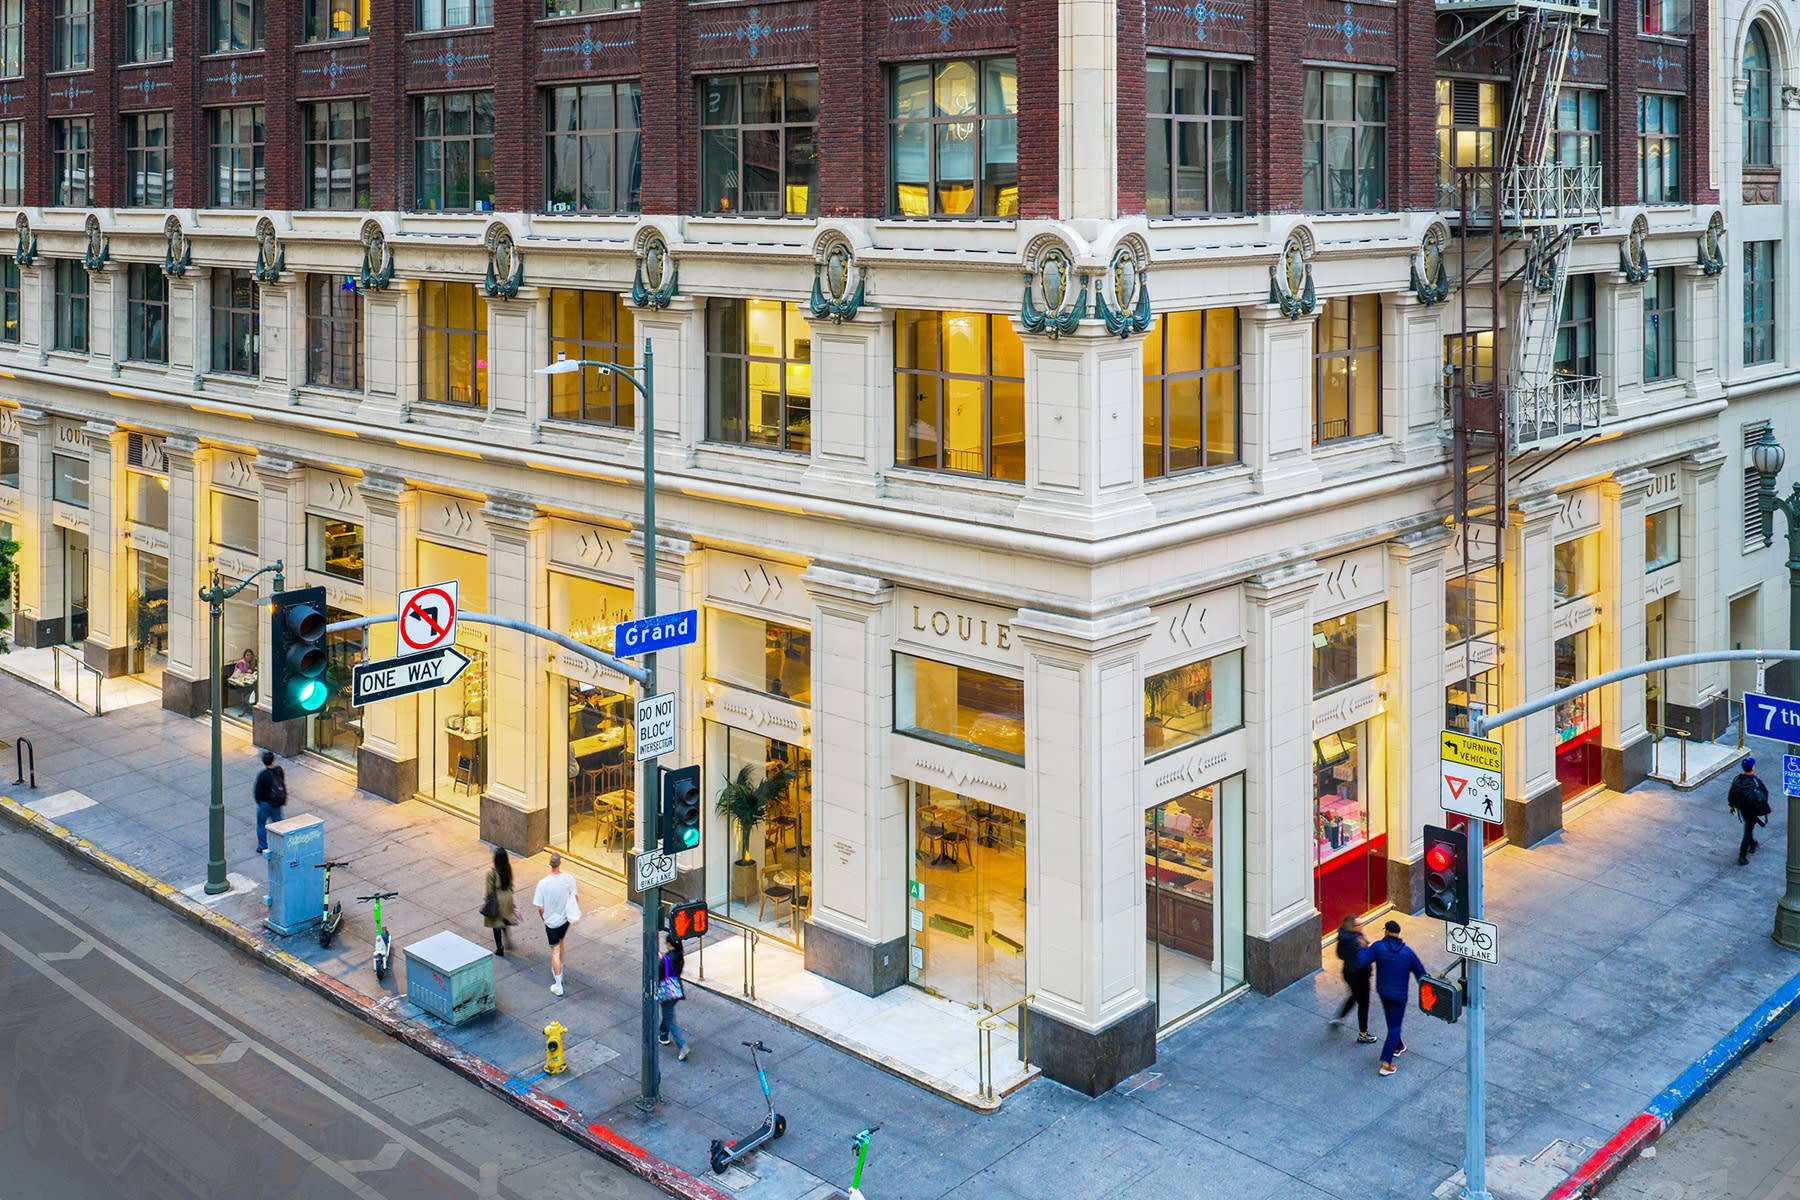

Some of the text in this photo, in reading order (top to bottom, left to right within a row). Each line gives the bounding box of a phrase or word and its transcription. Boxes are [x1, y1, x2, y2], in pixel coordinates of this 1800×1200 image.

[60, 426, 90, 447] LOUI
[625, 617, 688, 646] Grand
[913, 605, 1011, 650] LOUIE
[362, 659, 442, 693] ONE WAY
[639, 700, 673, 722] DO NOT
[1758, 703, 1800, 731] 7th
[1462, 740, 1498, 756] TURNING
[1460, 751, 1500, 768] VEHICLES
[1467, 787, 1478, 797] TO
[640, 871, 672, 888] BIKE LANE
[911, 884, 918, 896] A
[1451, 943, 1491, 960] BIKE LANE
